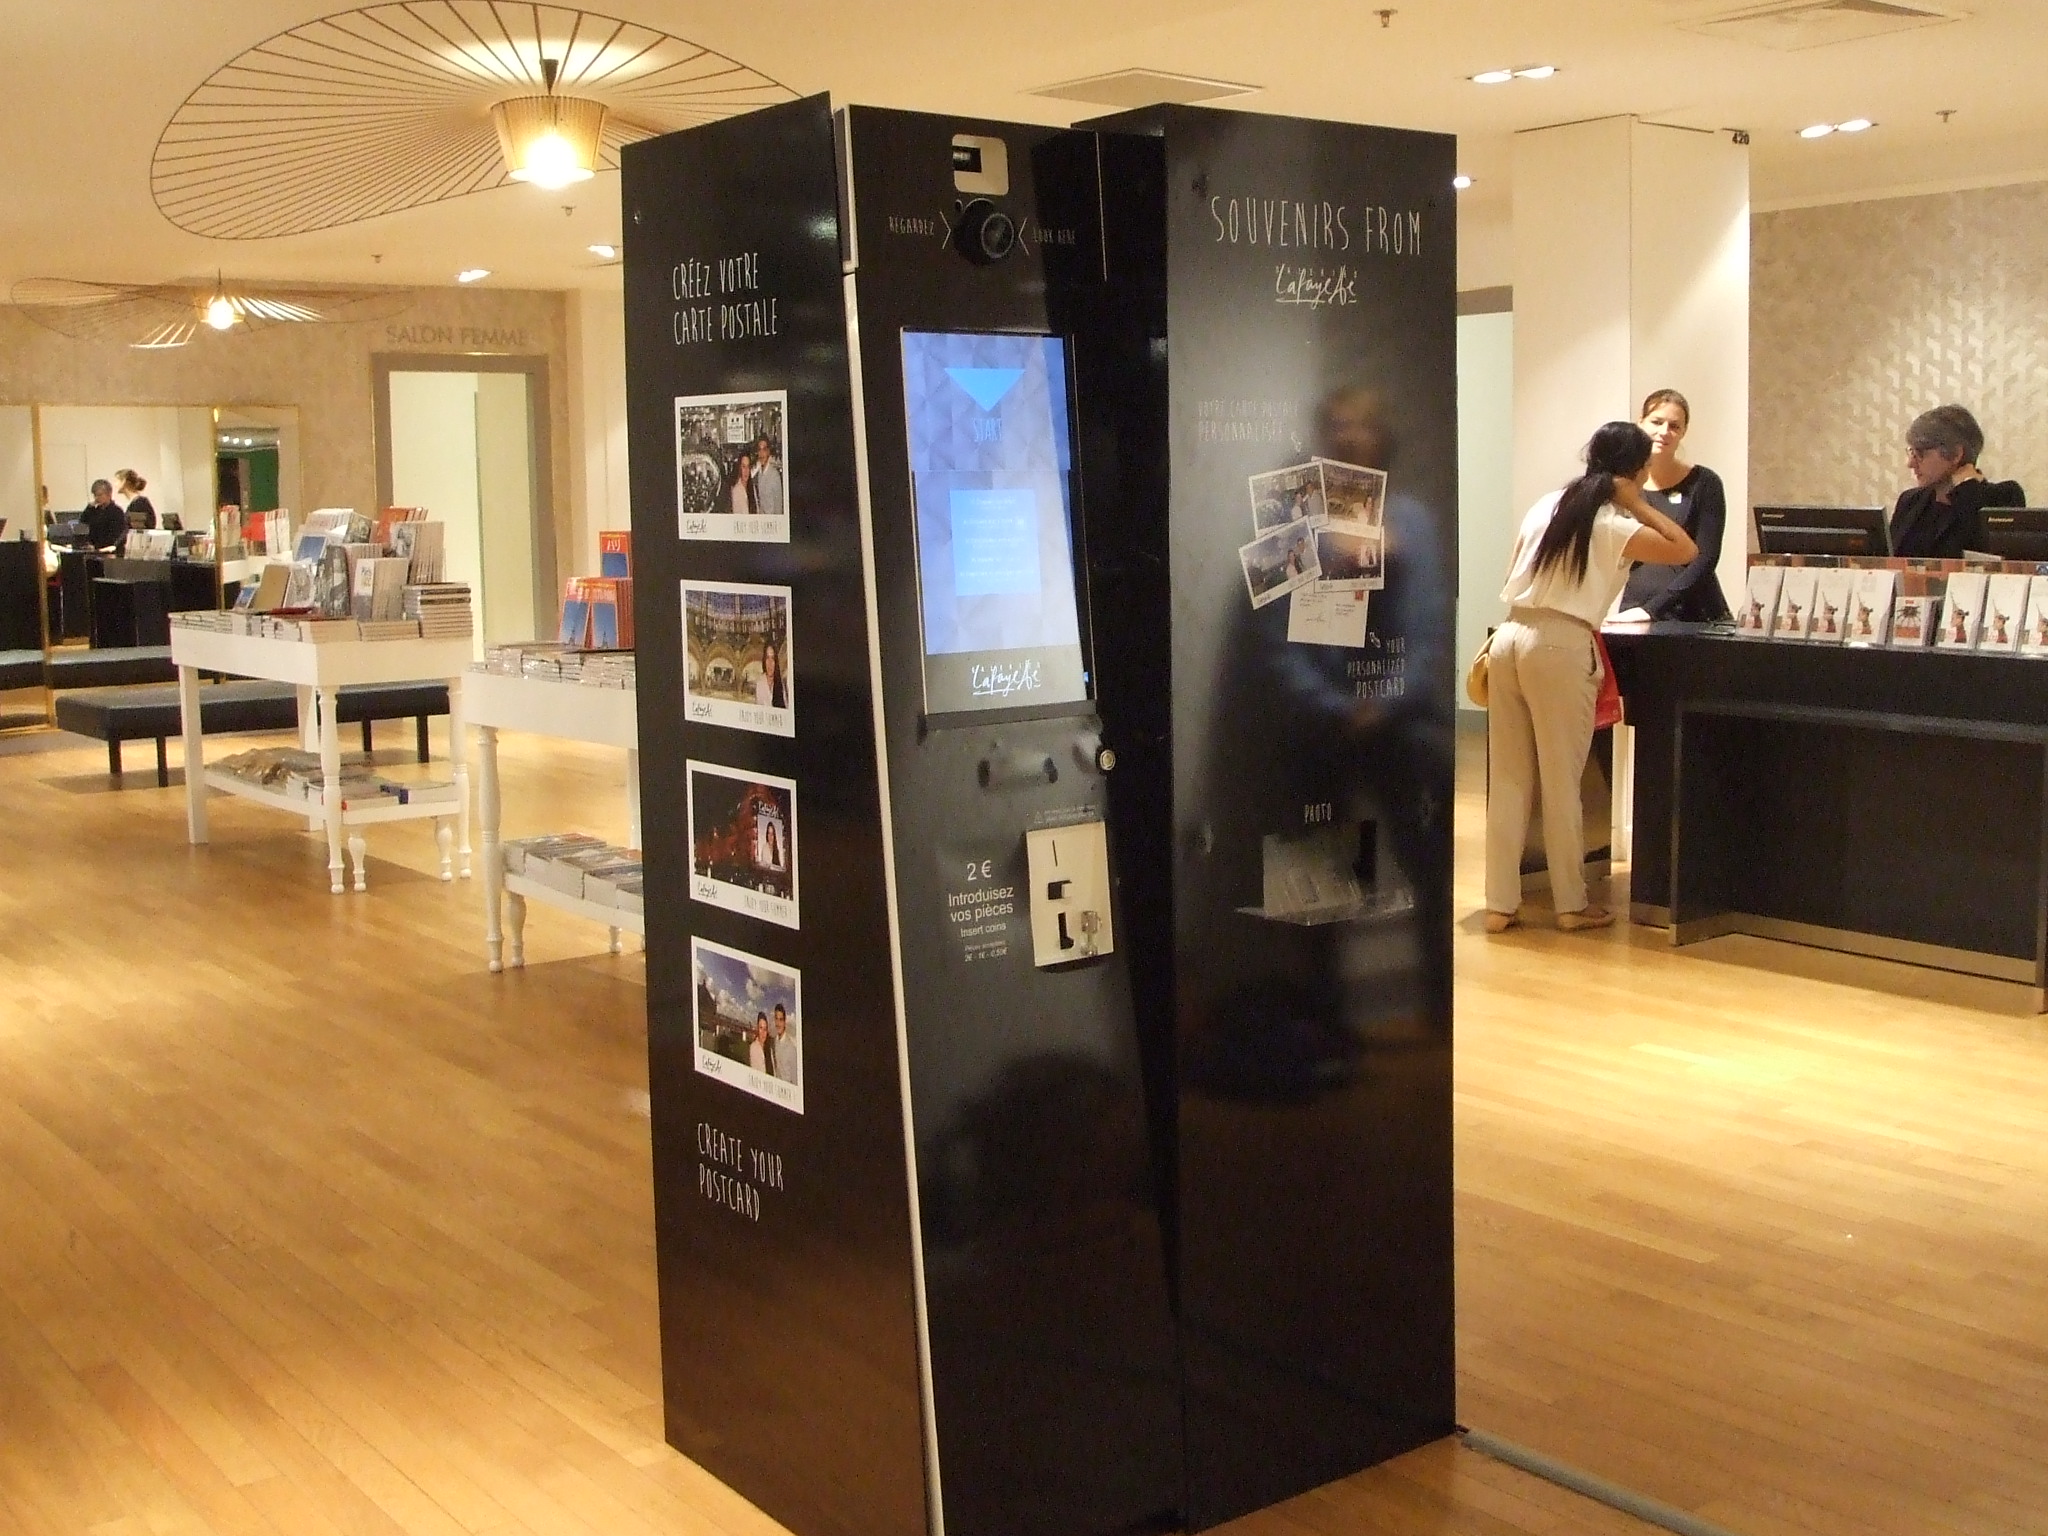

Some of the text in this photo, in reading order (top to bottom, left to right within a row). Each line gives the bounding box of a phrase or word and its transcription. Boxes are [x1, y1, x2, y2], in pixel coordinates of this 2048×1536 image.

[889, 216, 935, 236] REGARDEZ
[1211, 196, 1421, 255] SOUVENIRS FROM
[672, 252, 758, 300] CRÉEZ VOTRE
[1275, 262, 1357, 310] Lafayette
[674, 297, 778, 345] CARTE POSTALE
[386, 324, 529, 347] SALON FEMME
[972, 417, 1003, 443] START
[972, 659, 1041, 697] Lafayette
[1356, 677, 1405, 699] POSTCARD
[1304, 802, 1332, 824] PHOTO
[966, 860, 992, 881] 2 €
[948, 886, 1014, 907] Introduisez
[950, 902, 1014, 923] vos pièces
[960, 922, 1007, 937] Insert coins
[698, 1122, 784, 1192] CREATE YOUR
[699, 1162, 760, 1224] POSTCARD
